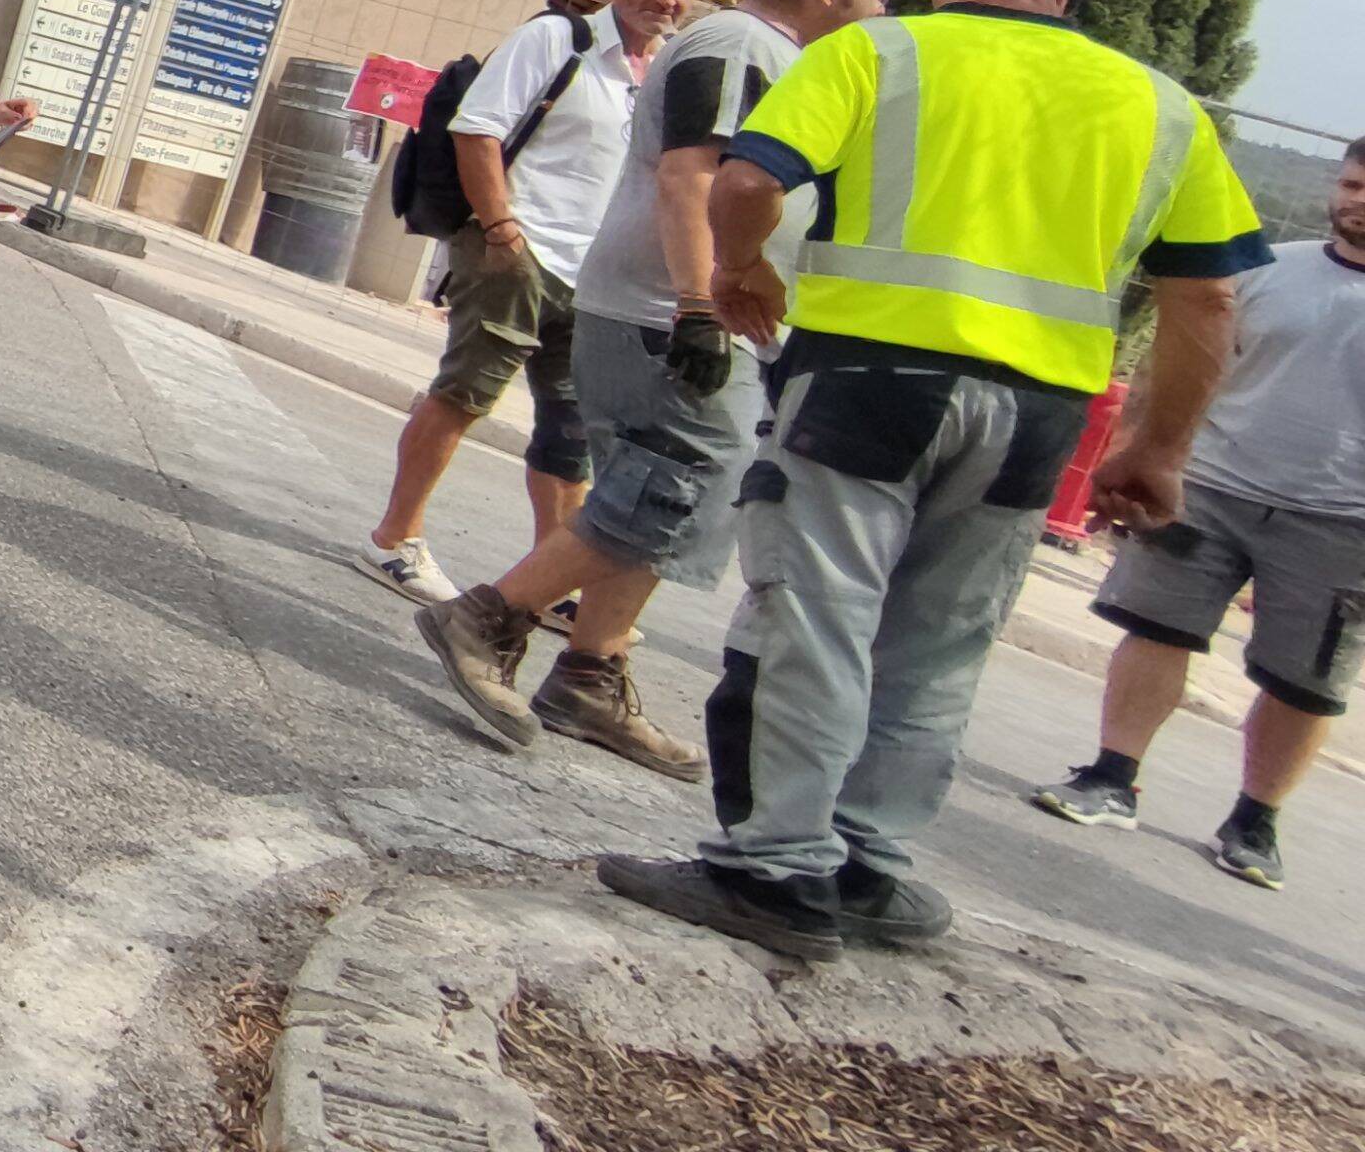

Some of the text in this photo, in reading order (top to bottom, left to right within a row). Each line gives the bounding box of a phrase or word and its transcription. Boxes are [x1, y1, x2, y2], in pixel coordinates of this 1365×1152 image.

[77, 2, 88, 14] Le
[60, 23, 83, 39] Cave
[51, 48, 73, 64] Snack
[156, 69, 193, 88] Skatepark
[141, 116, 188, 138] Pharmacie
[135, 141, 190, 165] Sage-Femme
